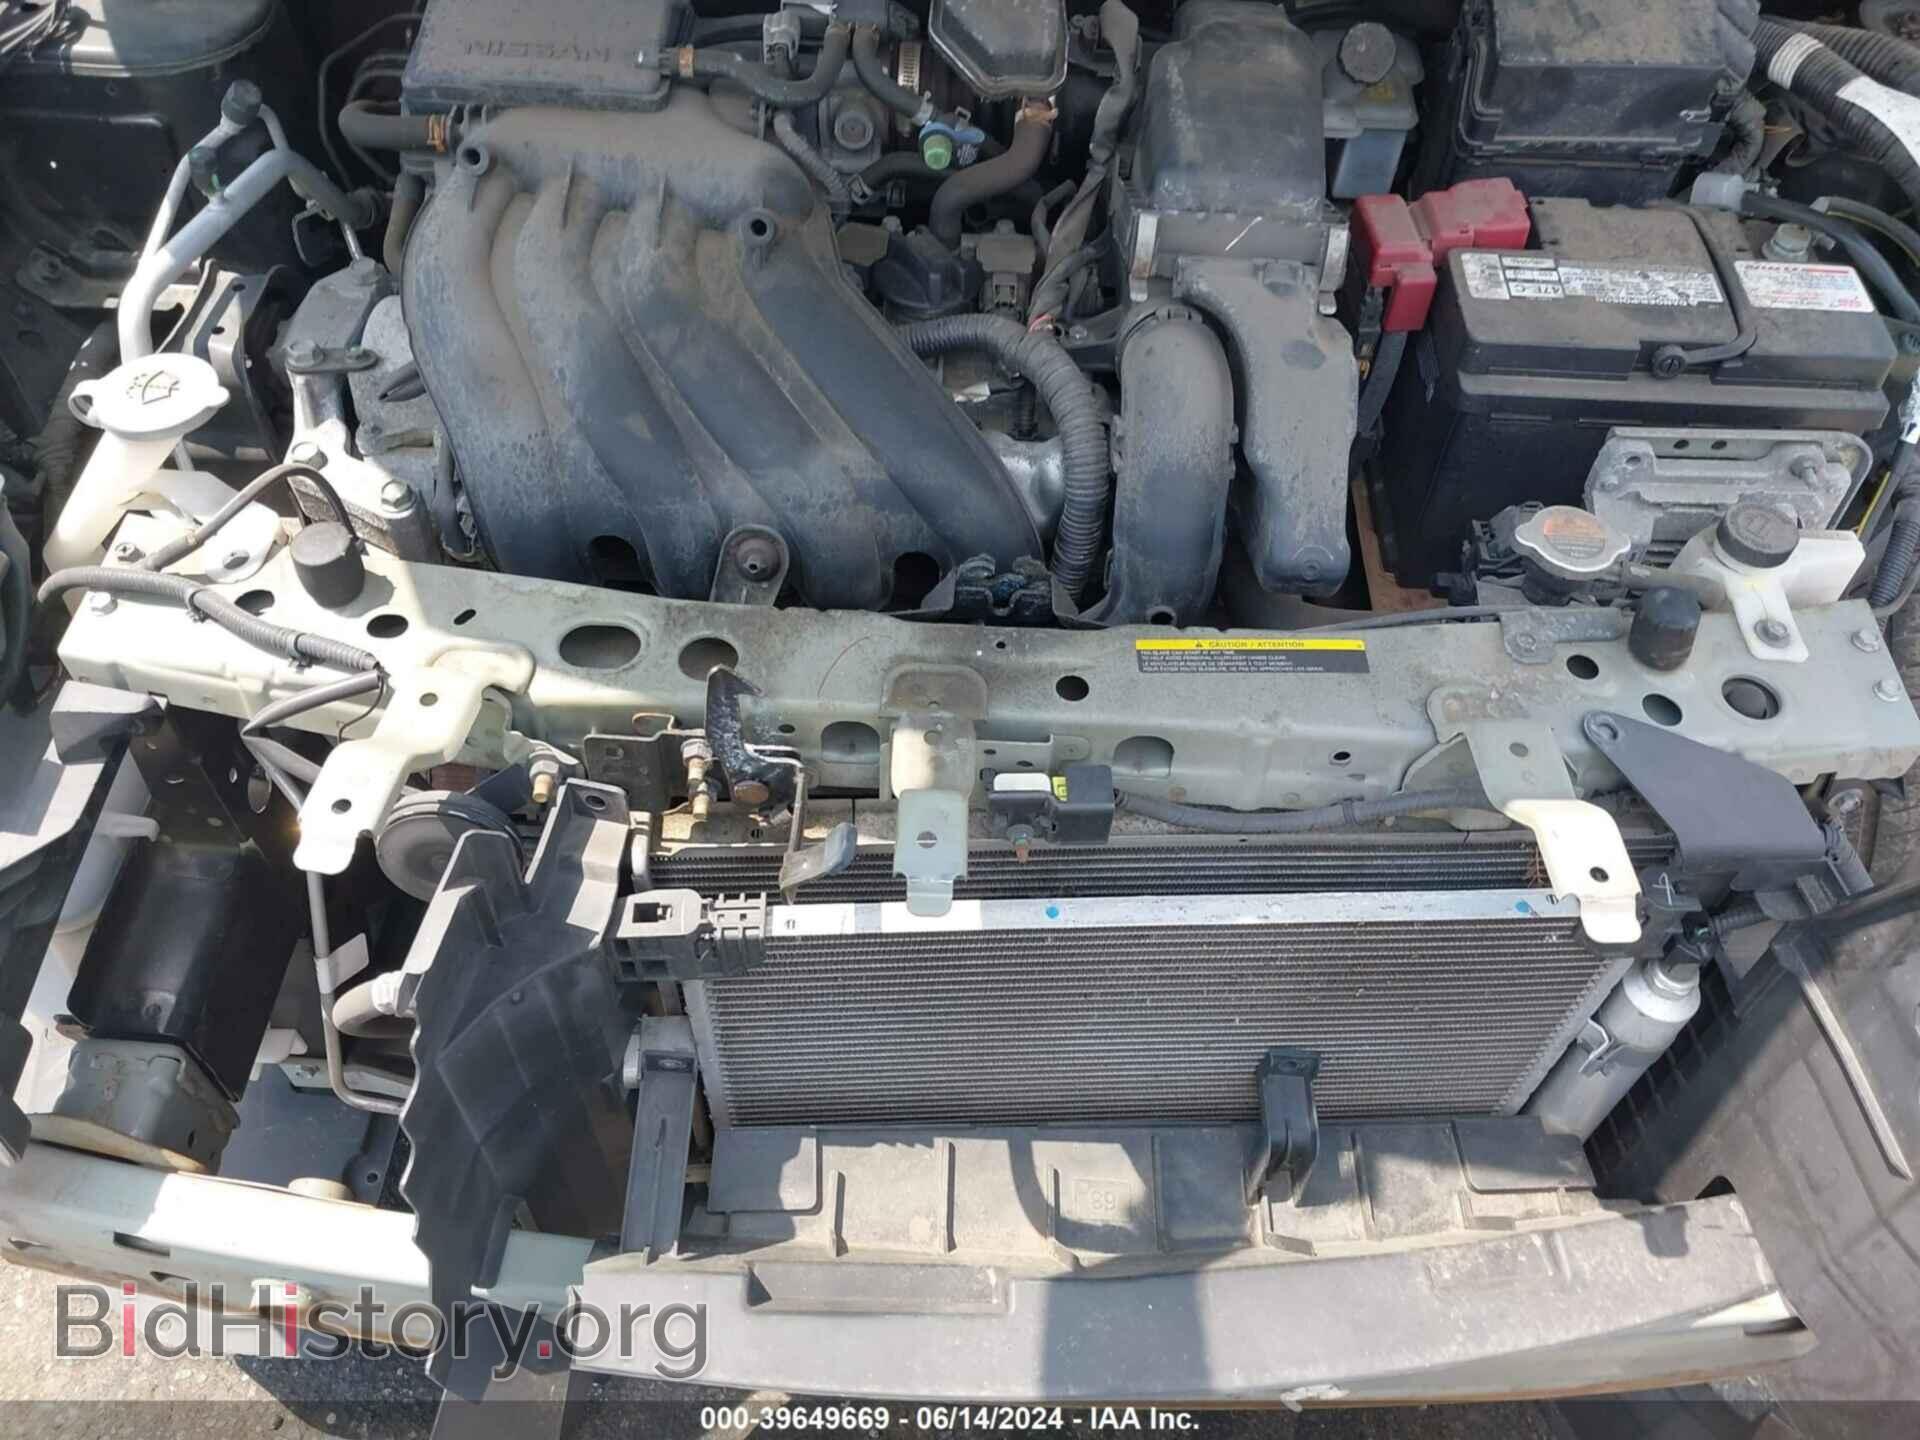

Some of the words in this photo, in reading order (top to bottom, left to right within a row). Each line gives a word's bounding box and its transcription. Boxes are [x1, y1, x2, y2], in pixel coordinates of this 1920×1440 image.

[458, 39, 612, 64] NISSAN
[1208, 641, 1248, 649] CAUTION
[1258, 641, 1305, 649] ATTENTION
